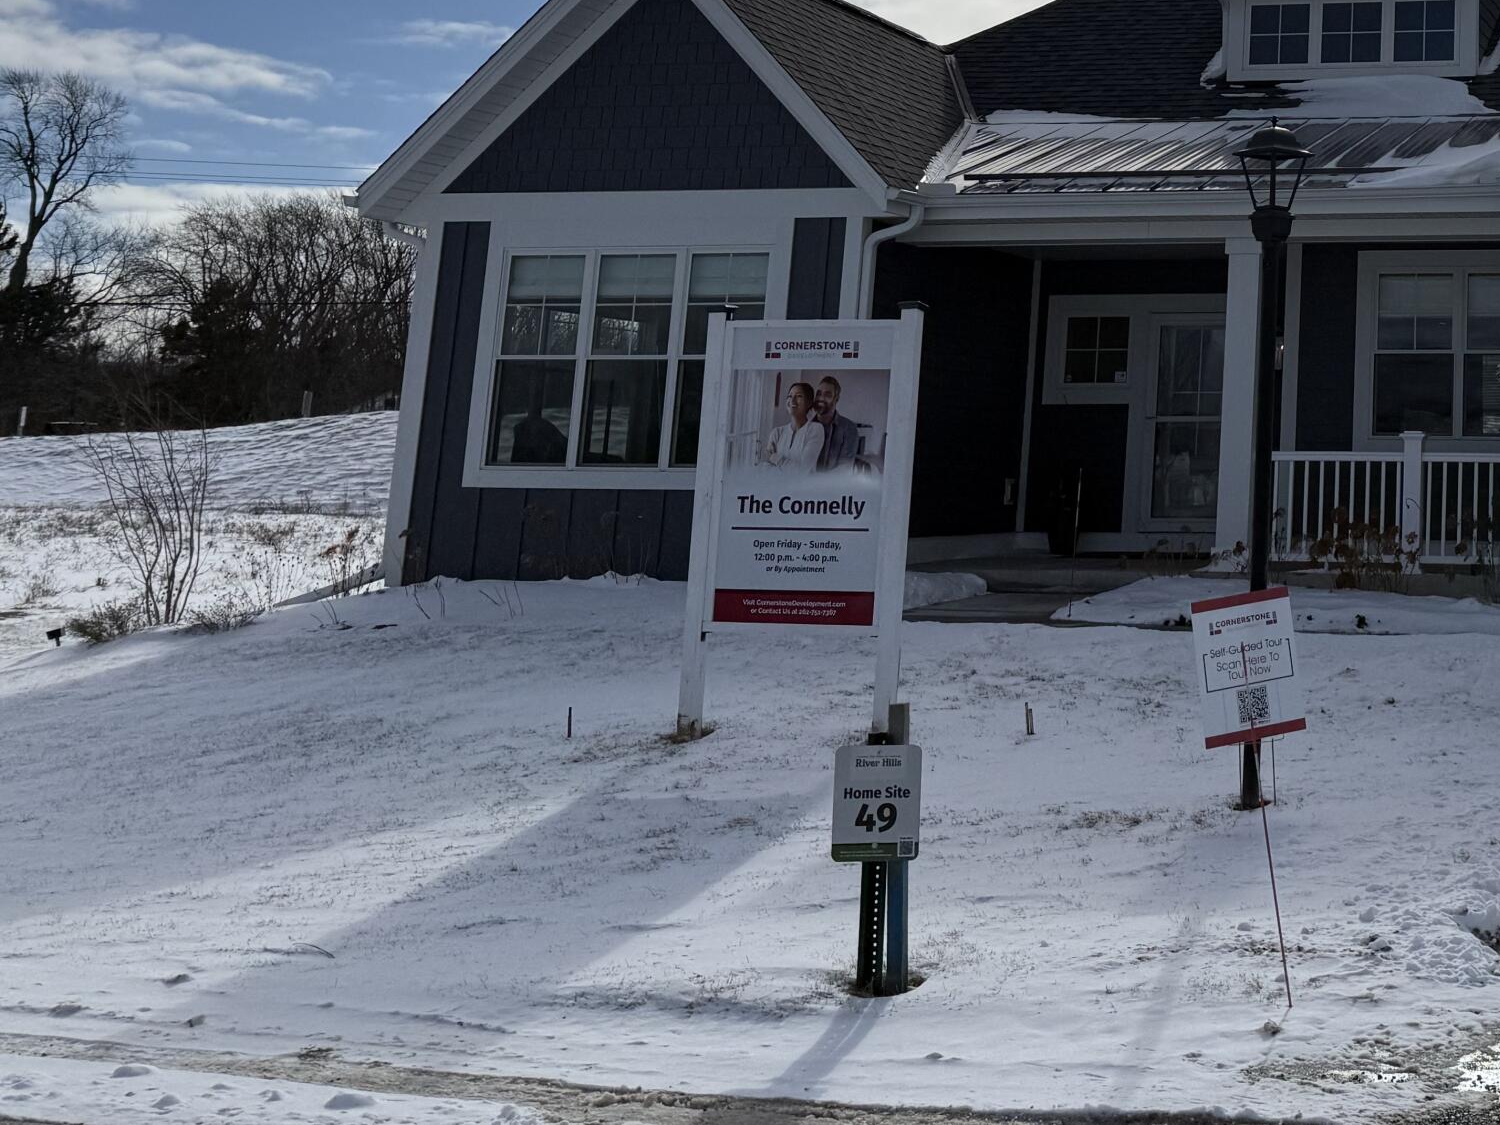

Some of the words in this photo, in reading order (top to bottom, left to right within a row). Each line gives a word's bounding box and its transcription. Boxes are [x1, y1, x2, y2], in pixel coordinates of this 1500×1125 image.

[774, 341, 851, 350] CORNERSTONE
[737, 494, 773, 514] The
[779, 495, 866, 520] Connelly
[753, 539, 775, 550] Open
[776, 539, 802, 551] Friday
[809, 540, 842, 551] Sunday,
[754, 553, 775, 562] 12:00
[777, 554, 795, 564] p.m.
[802, 553, 820, 563] 4:00
[821, 555, 839, 564] p.m.
[774, 565, 782, 573] By
[783, 565, 825, 574] Appointment
[756, 598, 846, 608] CornerstoneDevelopment.com
[1215, 611, 1271, 628] CORNERSTONE
[1210, 640, 1263, 659] Self-Guded
[1265, 638, 1283, 648] Tour
[1216, 659, 1242, 672] Scan
[1268, 651, 1280, 662] To
[1249, 664, 1272, 676] Now
[855, 758, 880, 768] River
[882, 758, 902, 767] Hills
[844, 787, 882, 799] Home
[885, 784, 911, 799] Site
[855, 803, 898, 833] 49
